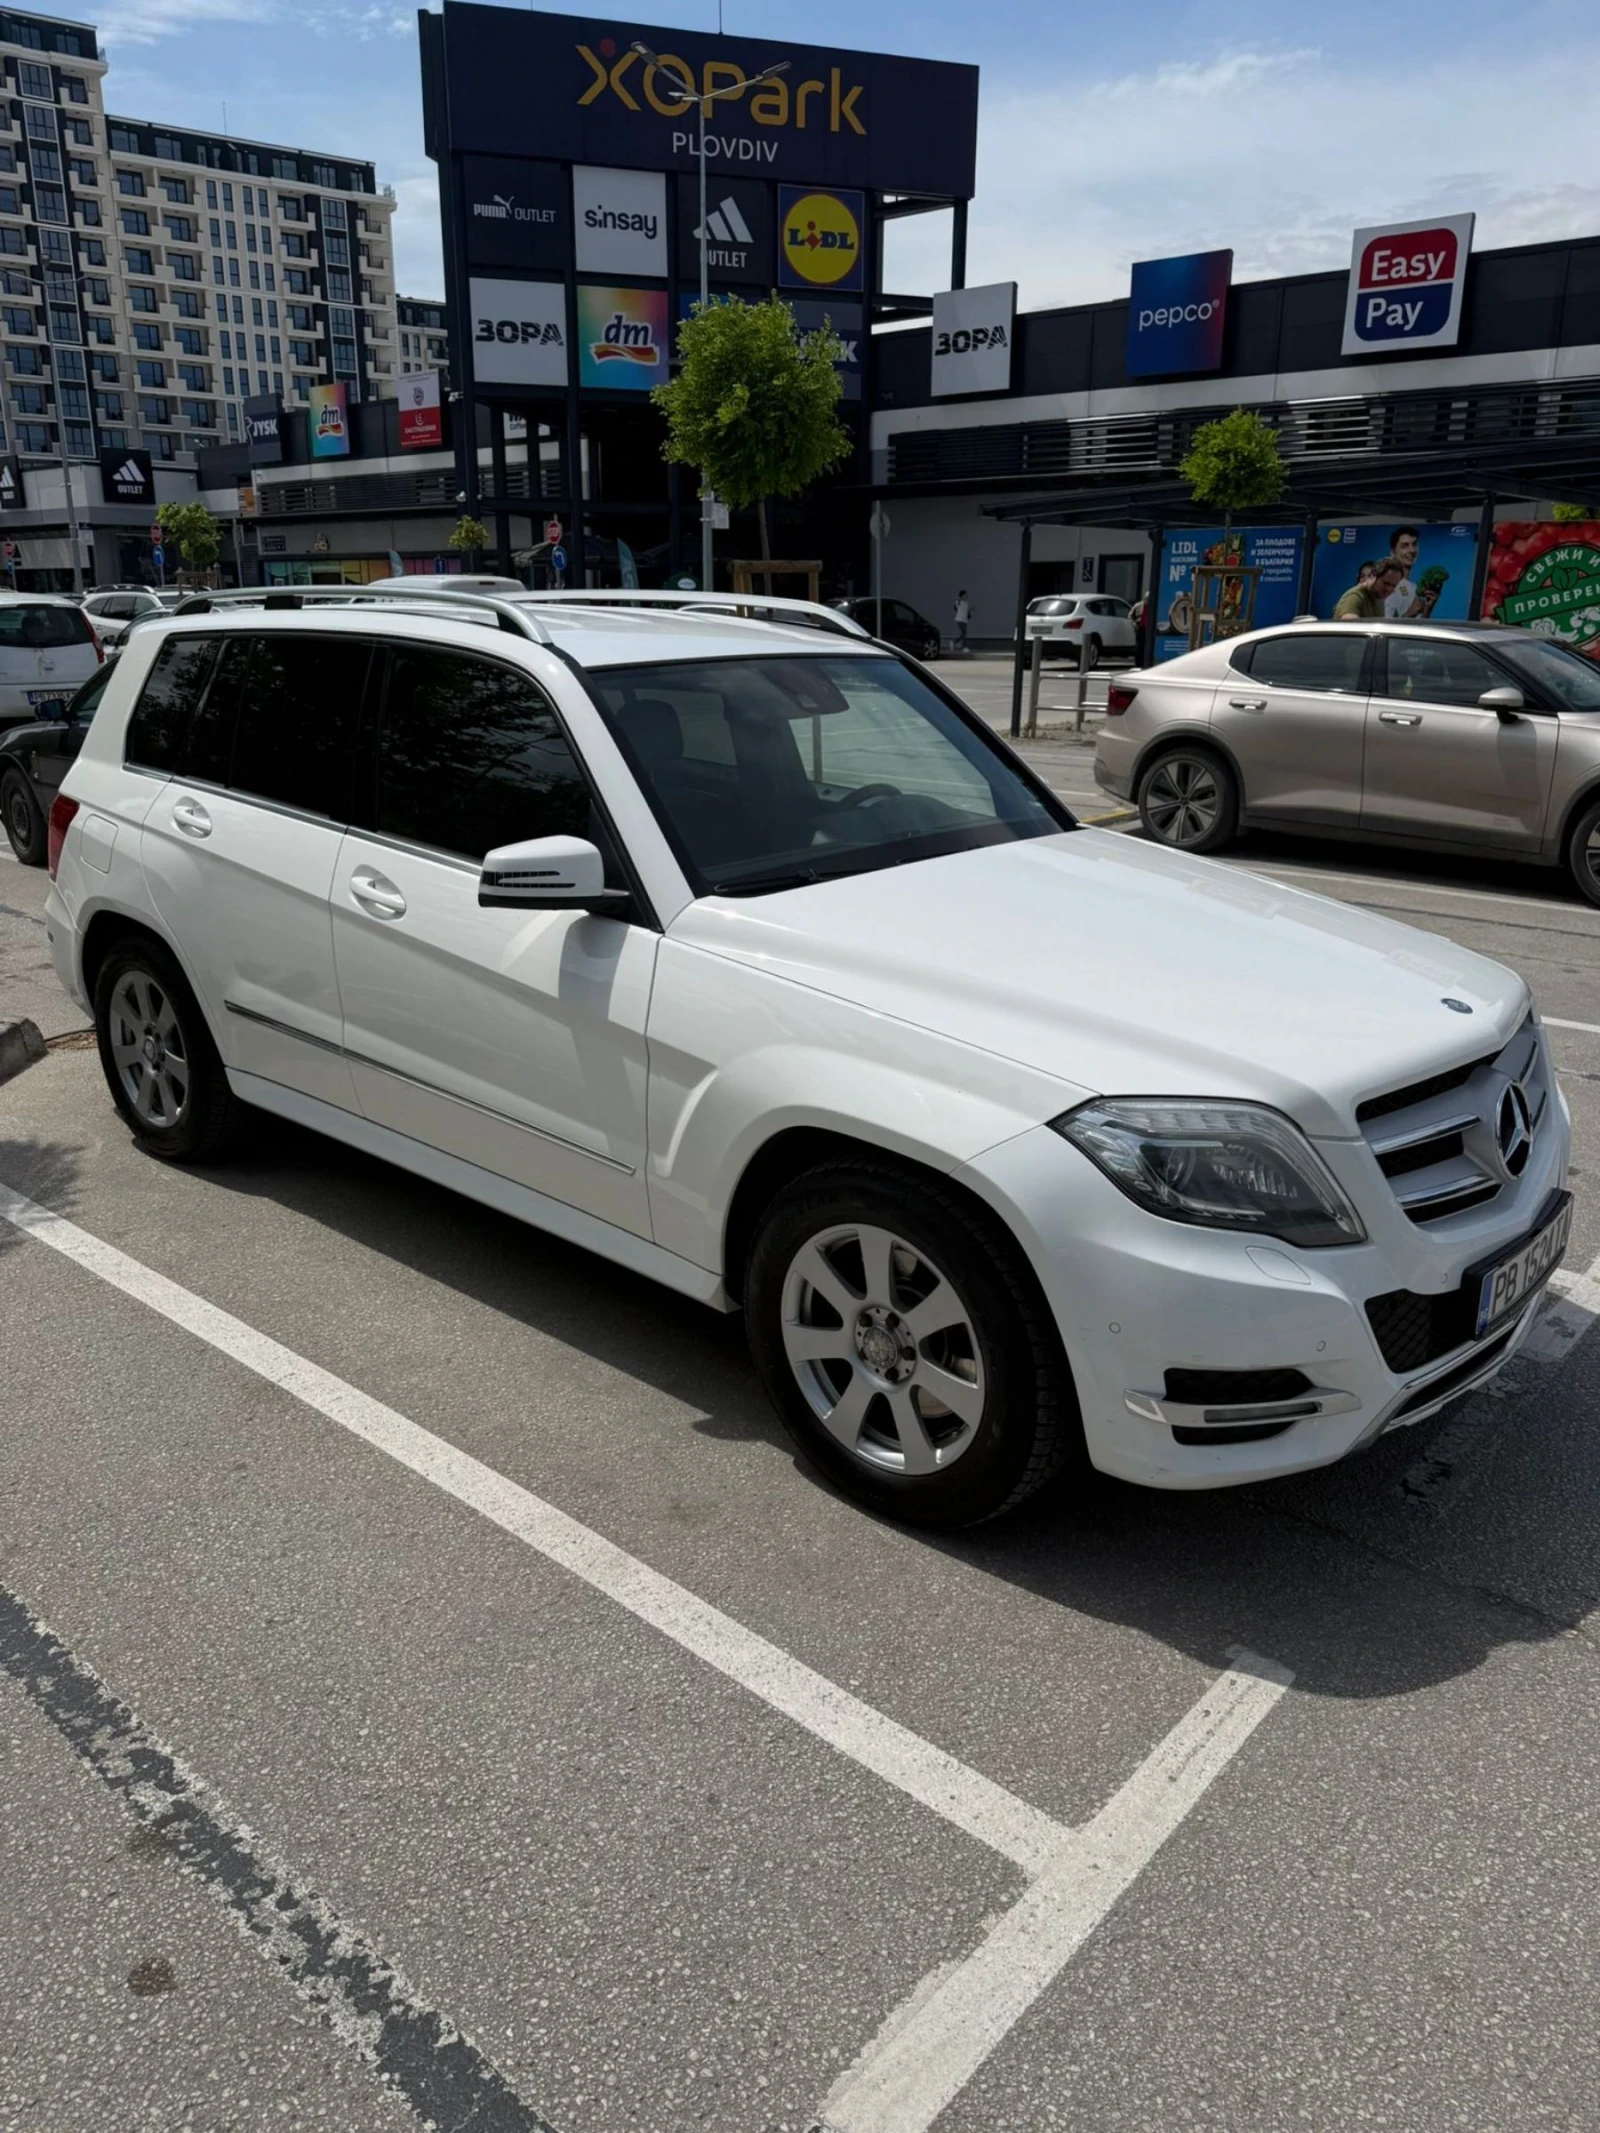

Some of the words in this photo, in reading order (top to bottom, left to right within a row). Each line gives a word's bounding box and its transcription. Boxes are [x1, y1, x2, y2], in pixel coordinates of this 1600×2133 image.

[672, 132, 778, 163] PLOVDIV
[515, 207, 556, 223] OUTLET
[584, 204, 657, 240] sinsay
[708, 249, 747, 268] UTLET
[1370, 248, 1446, 282] Easy
[1366, 295, 1424, 331] Pay
[475, 318, 565, 347] ЗОРА
[604, 314, 650, 346] dm
[934, 323, 1009, 357] ЗОРА
[253, 419, 278, 437] JYSK
[320, 405, 339, 424] dm
[117, 485, 143, 494] OUTLET
[1171, 542, 1198, 554] LIDL
[1526, 549, 1583, 583] СВЕЖИ
[1491, 1263, 1518, 1317] PB
